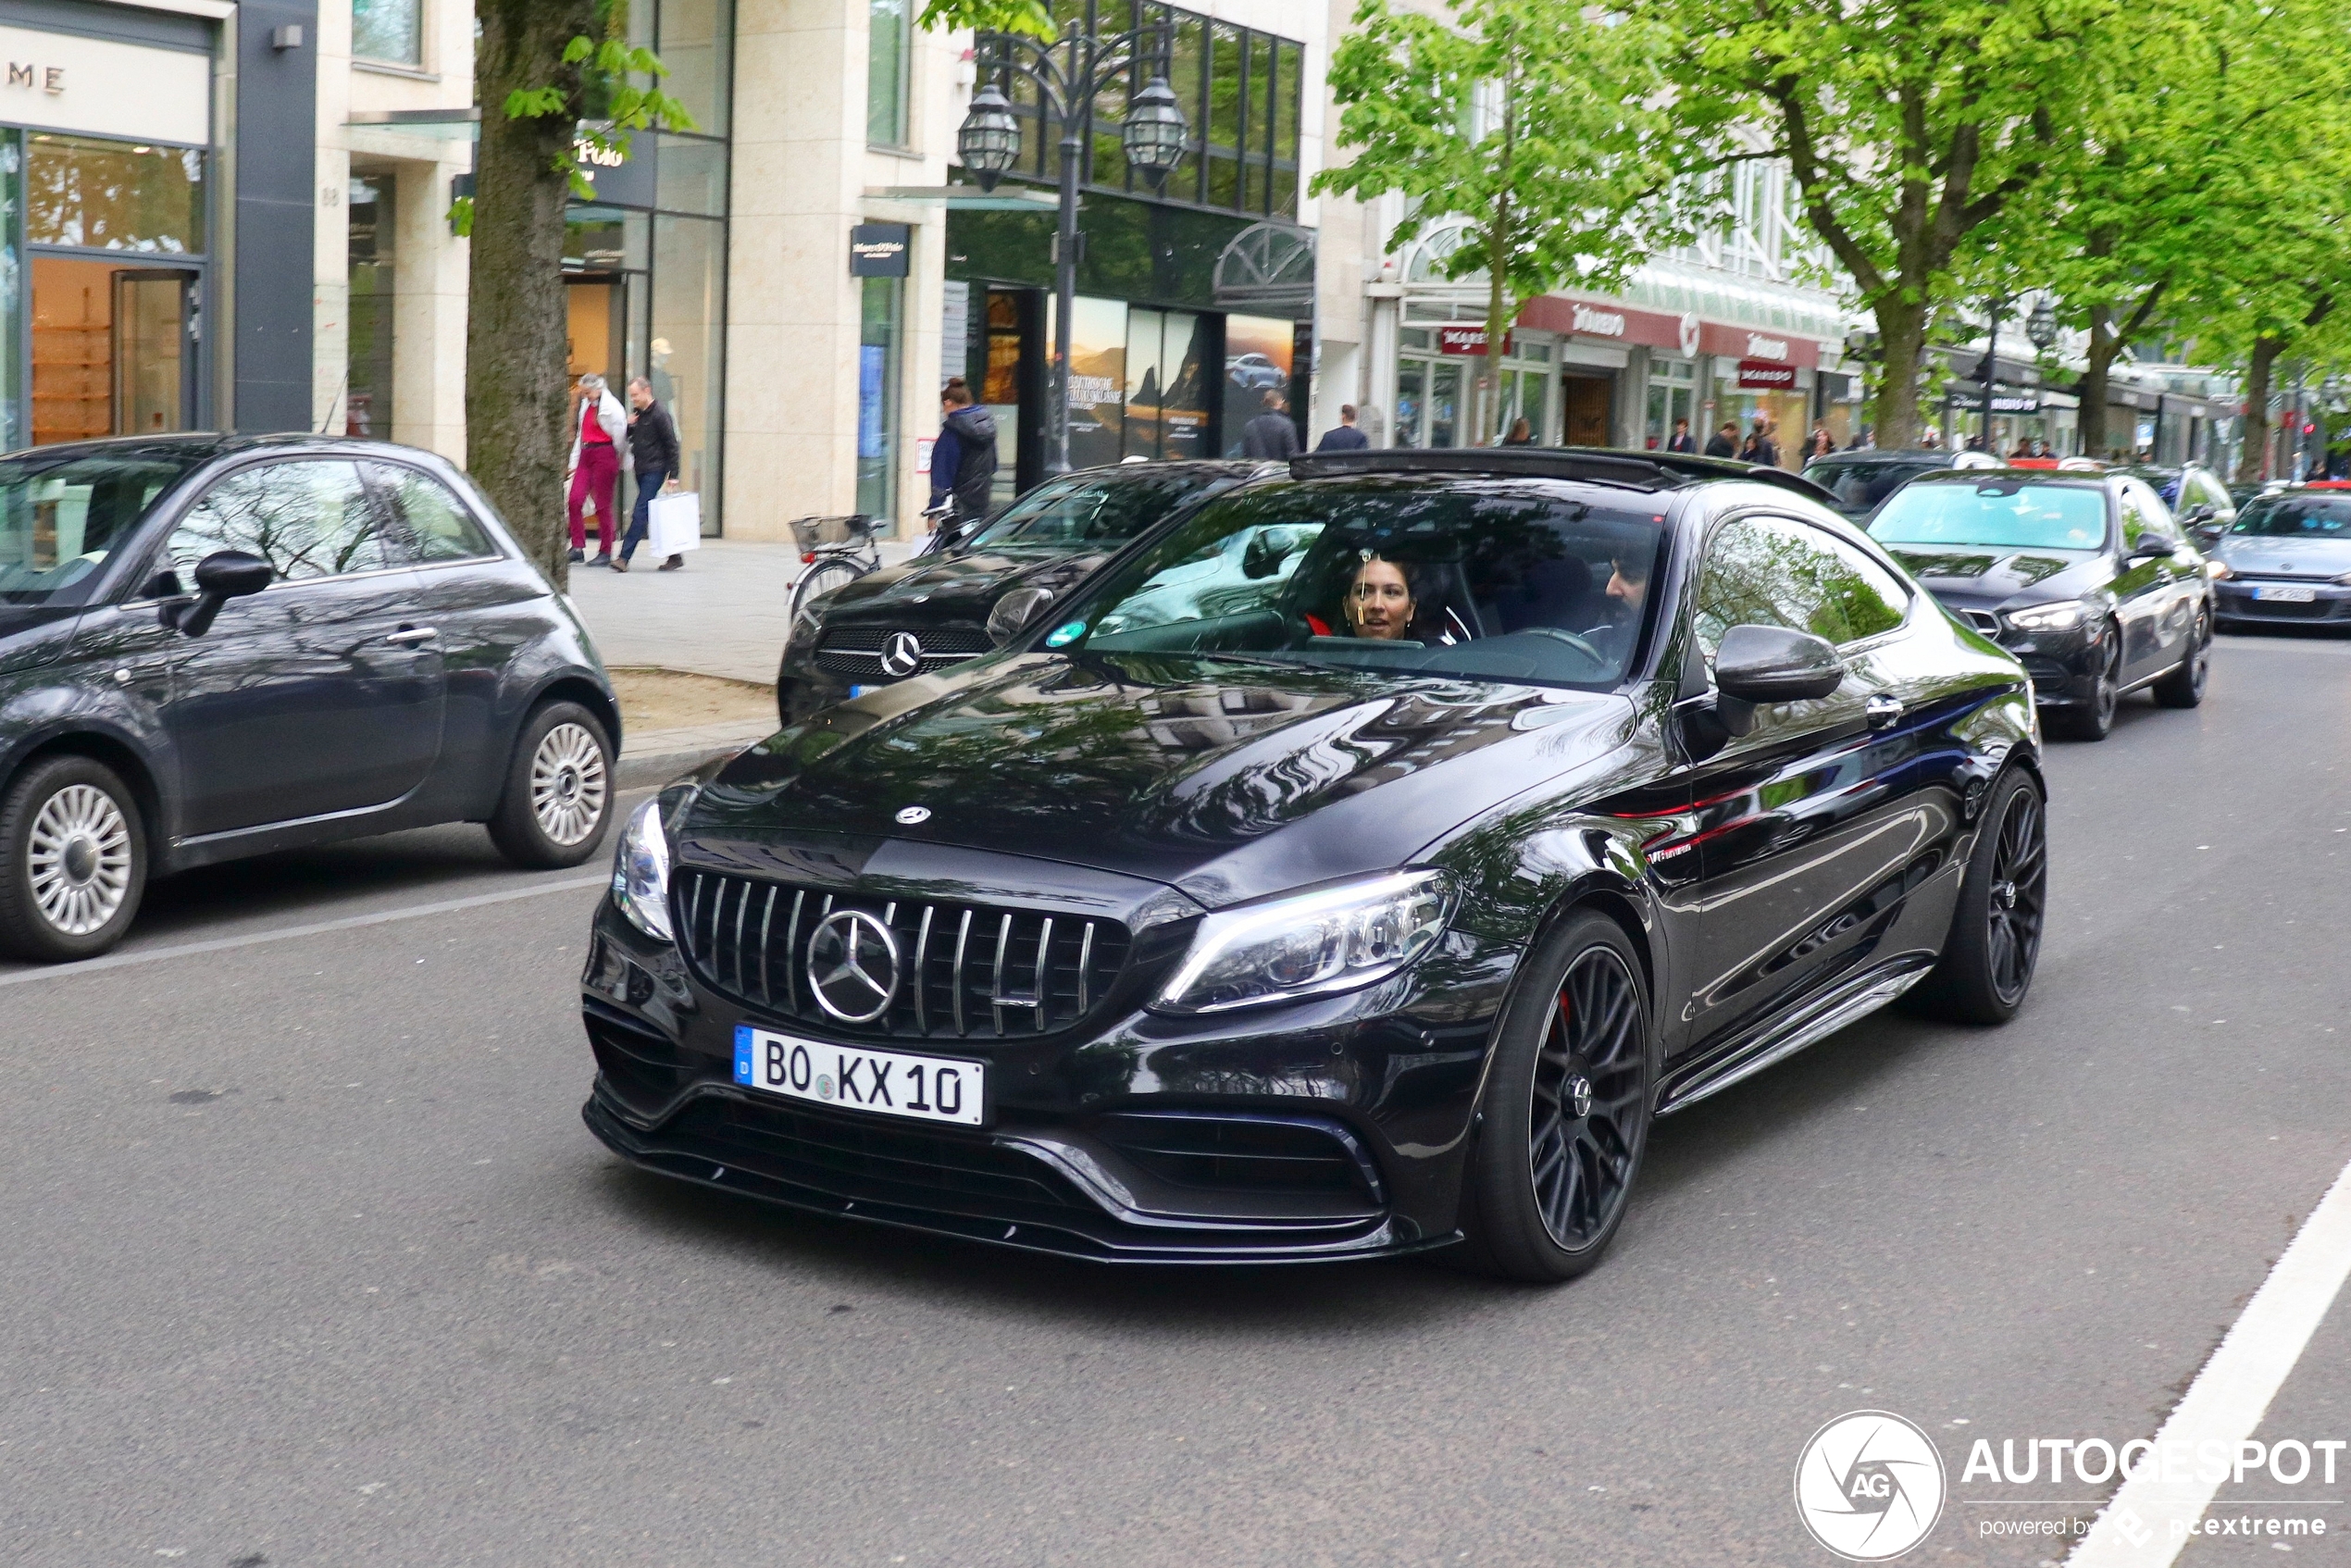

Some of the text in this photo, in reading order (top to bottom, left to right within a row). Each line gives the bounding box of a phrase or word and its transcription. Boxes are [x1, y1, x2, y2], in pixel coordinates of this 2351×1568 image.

[740, 1061, 749, 1075] D
[766, 1039, 961, 1114] BO KX 10
